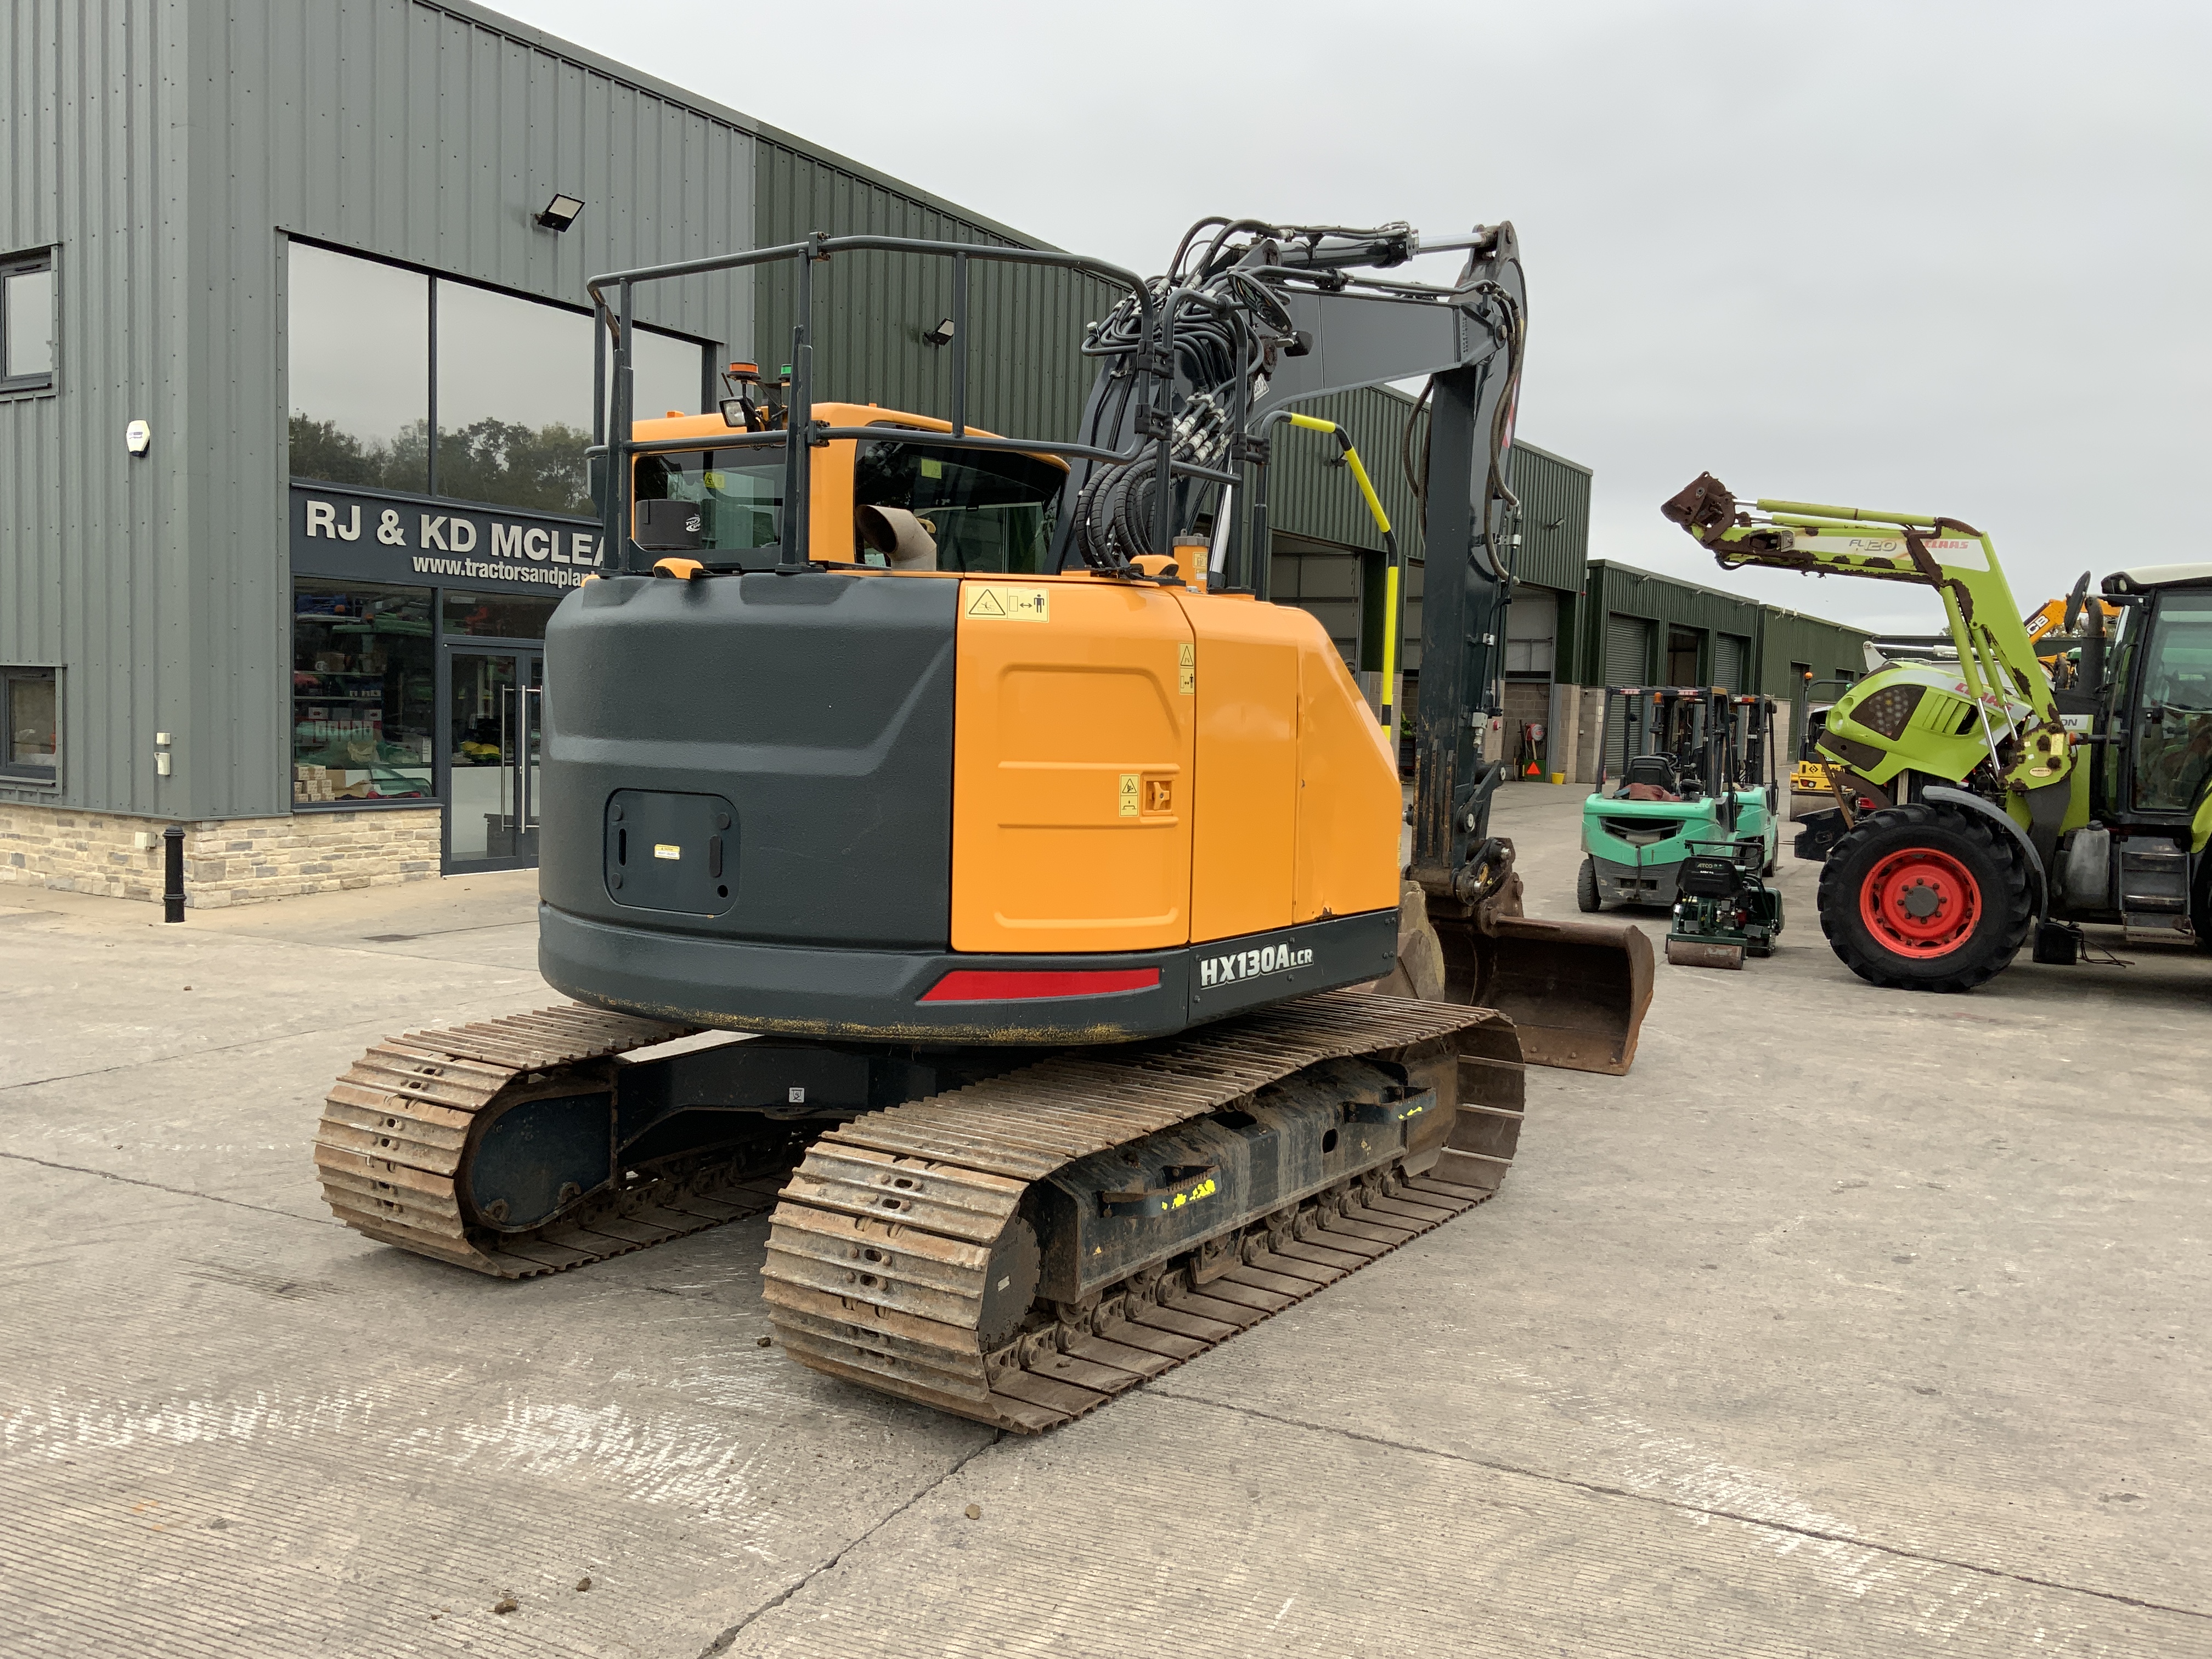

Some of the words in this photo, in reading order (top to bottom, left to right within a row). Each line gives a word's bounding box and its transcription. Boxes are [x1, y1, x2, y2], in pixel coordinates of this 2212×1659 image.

[307, 500, 360, 540] RJ
[377, 509, 407, 546] &
[421, 514, 477, 552] KD
[1924, 540, 1969, 549] CLAAS
[413, 556, 596, 589] www.tractorsandpla
[2026, 615, 2049, 635] CB
